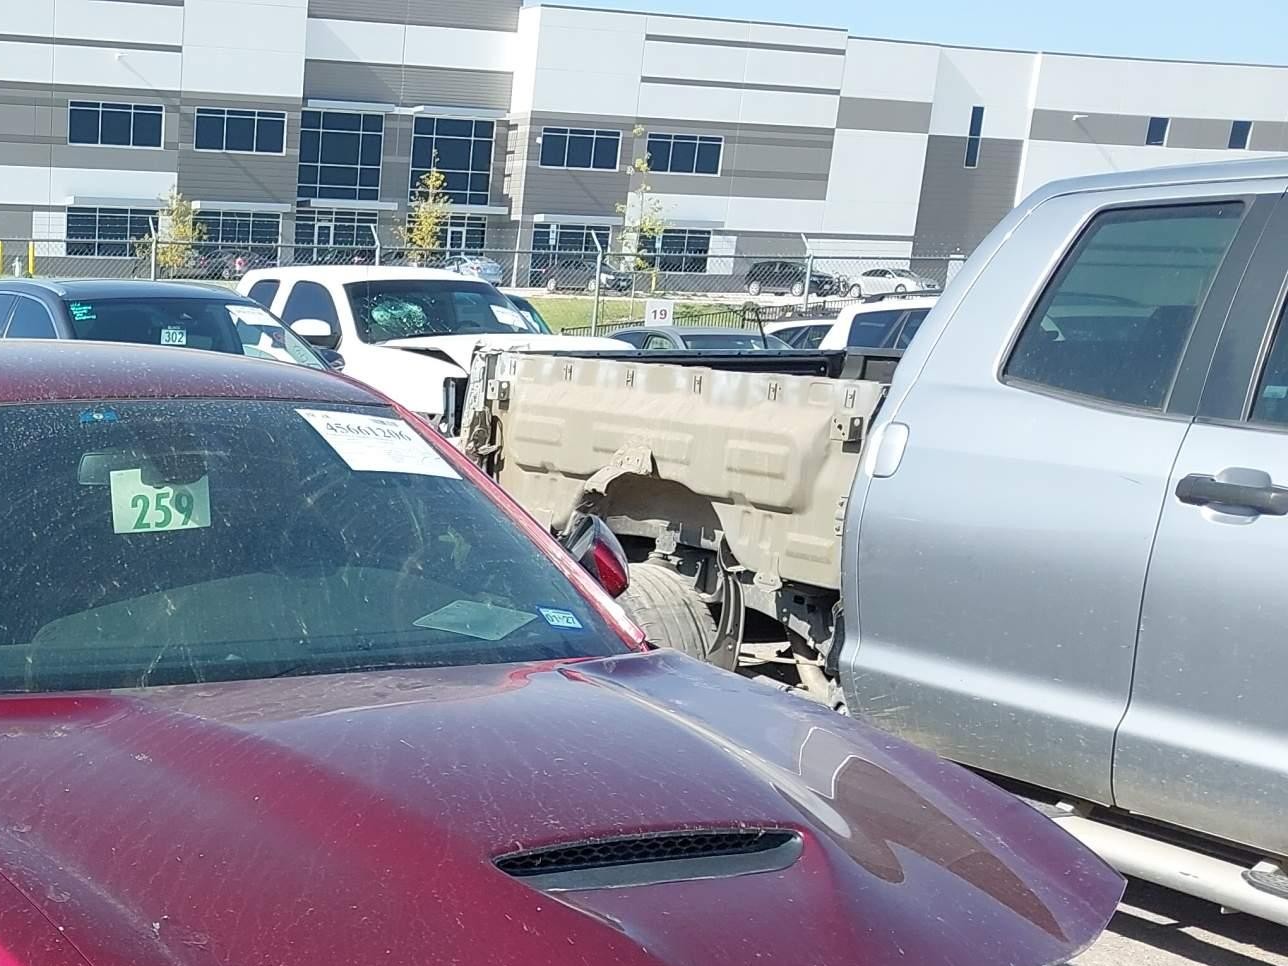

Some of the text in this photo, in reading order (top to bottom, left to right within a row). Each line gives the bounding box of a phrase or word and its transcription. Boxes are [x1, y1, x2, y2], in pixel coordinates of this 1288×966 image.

[651, 308, 668, 320] 19
[164, 331, 185, 343] 302
[326, 421, 412, 441] 45661206
[131, 491, 194, 530] 259
